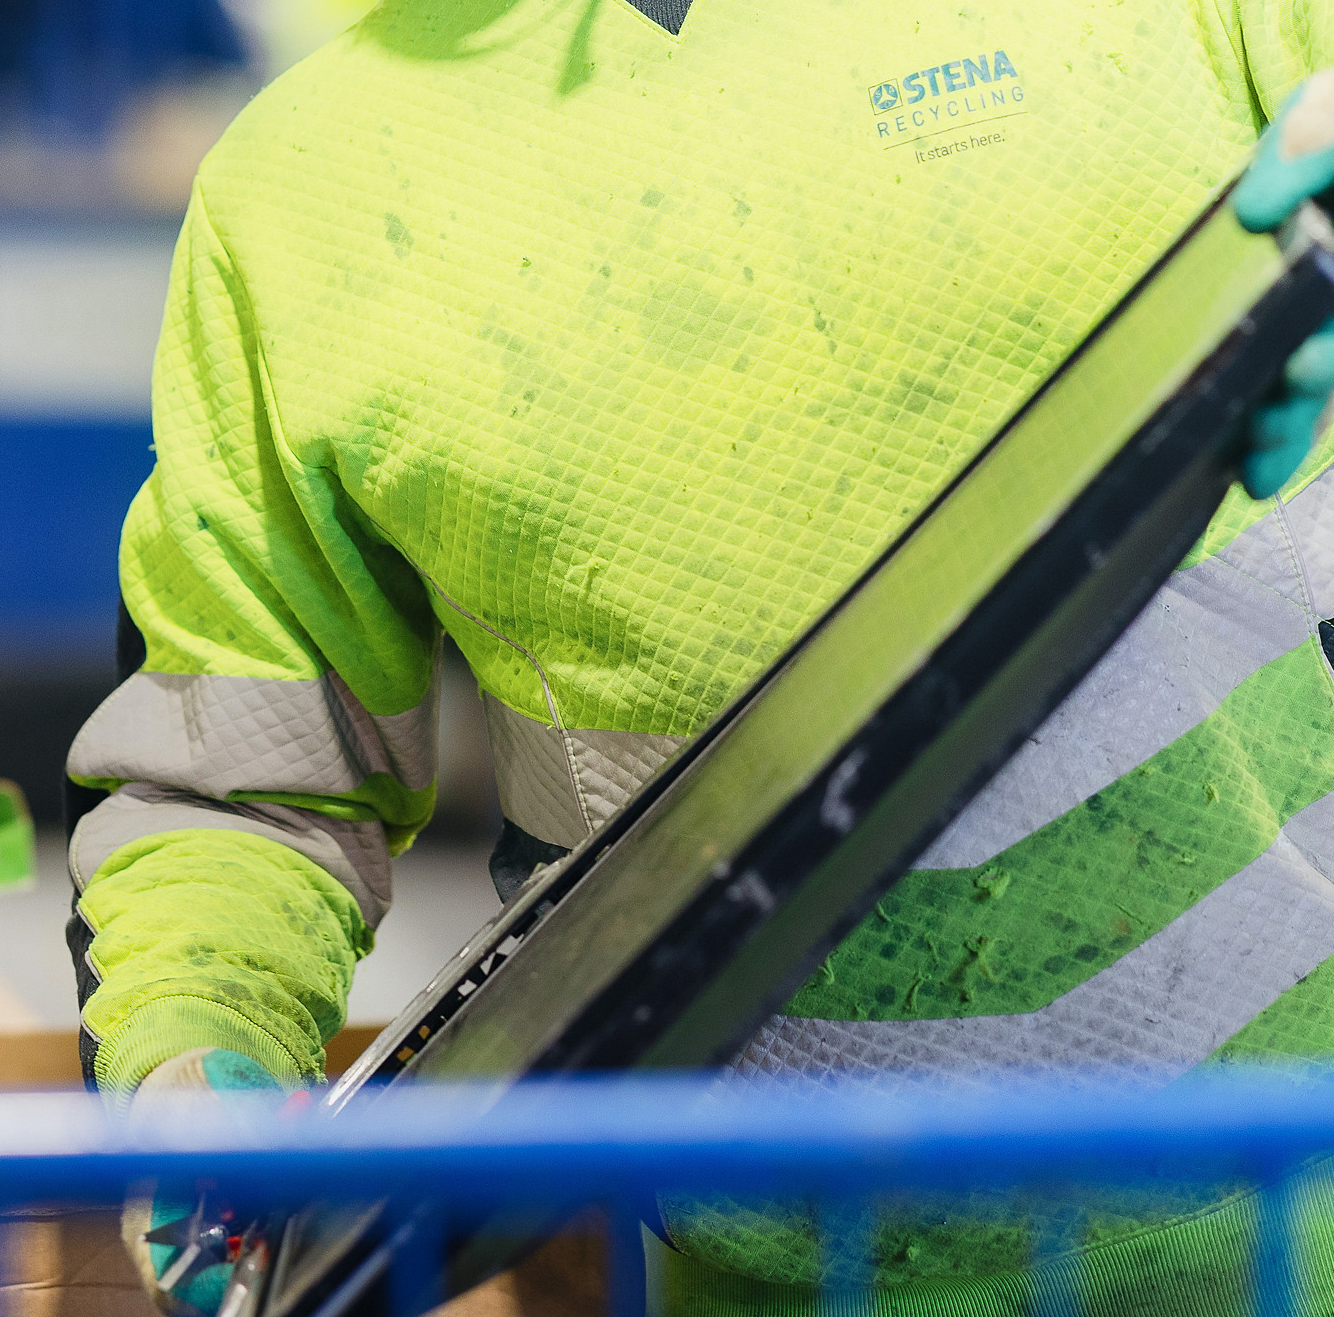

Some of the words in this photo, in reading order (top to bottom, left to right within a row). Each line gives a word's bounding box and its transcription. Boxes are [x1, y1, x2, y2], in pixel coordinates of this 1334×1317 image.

[902, 50, 1019, 105] STENA
[876, 86, 1025, 139] RECYCLING
[915, 150, 926, 164] It
[927, 140, 968, 160] starts
[969, 133, 1006, 149] here.
